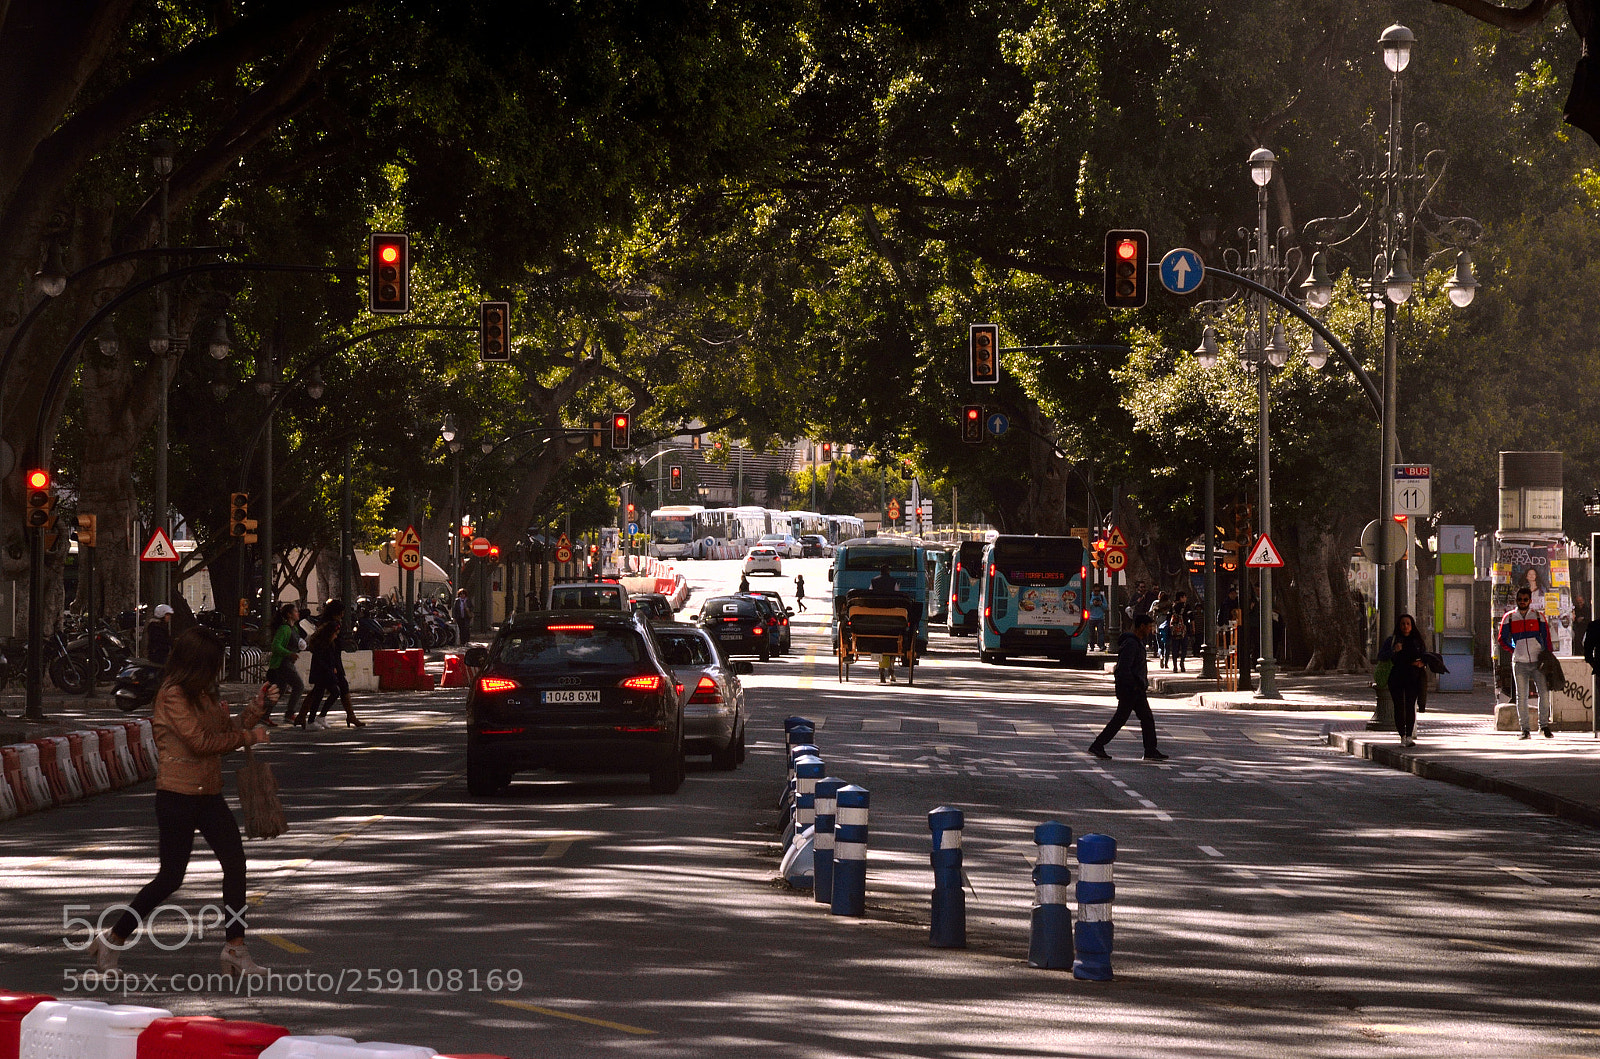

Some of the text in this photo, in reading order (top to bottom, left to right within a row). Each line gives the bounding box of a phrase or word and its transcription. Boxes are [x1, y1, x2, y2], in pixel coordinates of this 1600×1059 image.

[1409, 467, 1429, 476] BUS
[1403, 489, 1418, 509] 11
[403, 554, 418, 563] 30
[1108, 555, 1123, 564] 30
[548, 691, 599, 702] 1048 GXM
